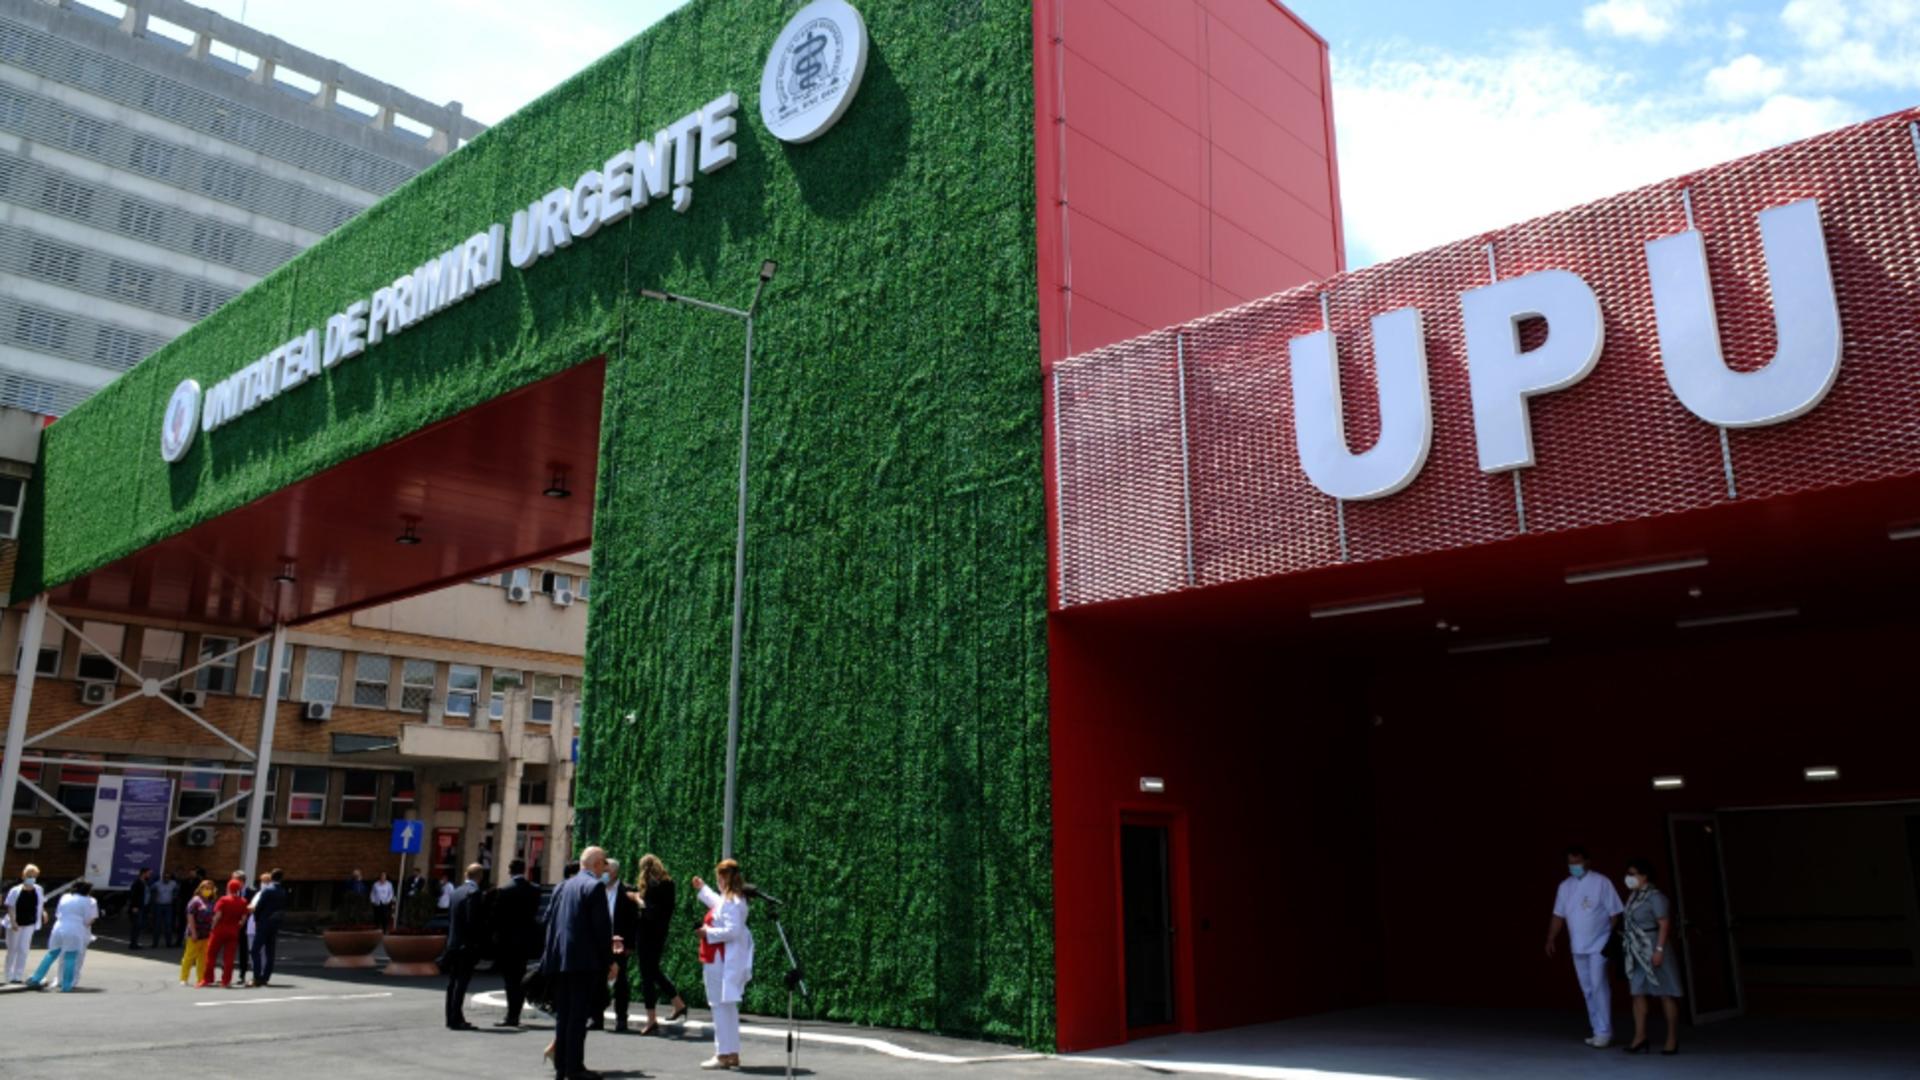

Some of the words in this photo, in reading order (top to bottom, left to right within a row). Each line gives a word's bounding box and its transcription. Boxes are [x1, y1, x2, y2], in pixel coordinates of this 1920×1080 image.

[201, 329, 321, 432] UNITATEA
[323, 301, 369, 367] DE
[368, 223, 504, 345] PRIMIRI
[509, 92, 739, 269] URGENȚE
[1289, 197, 1844, 500] UPU
